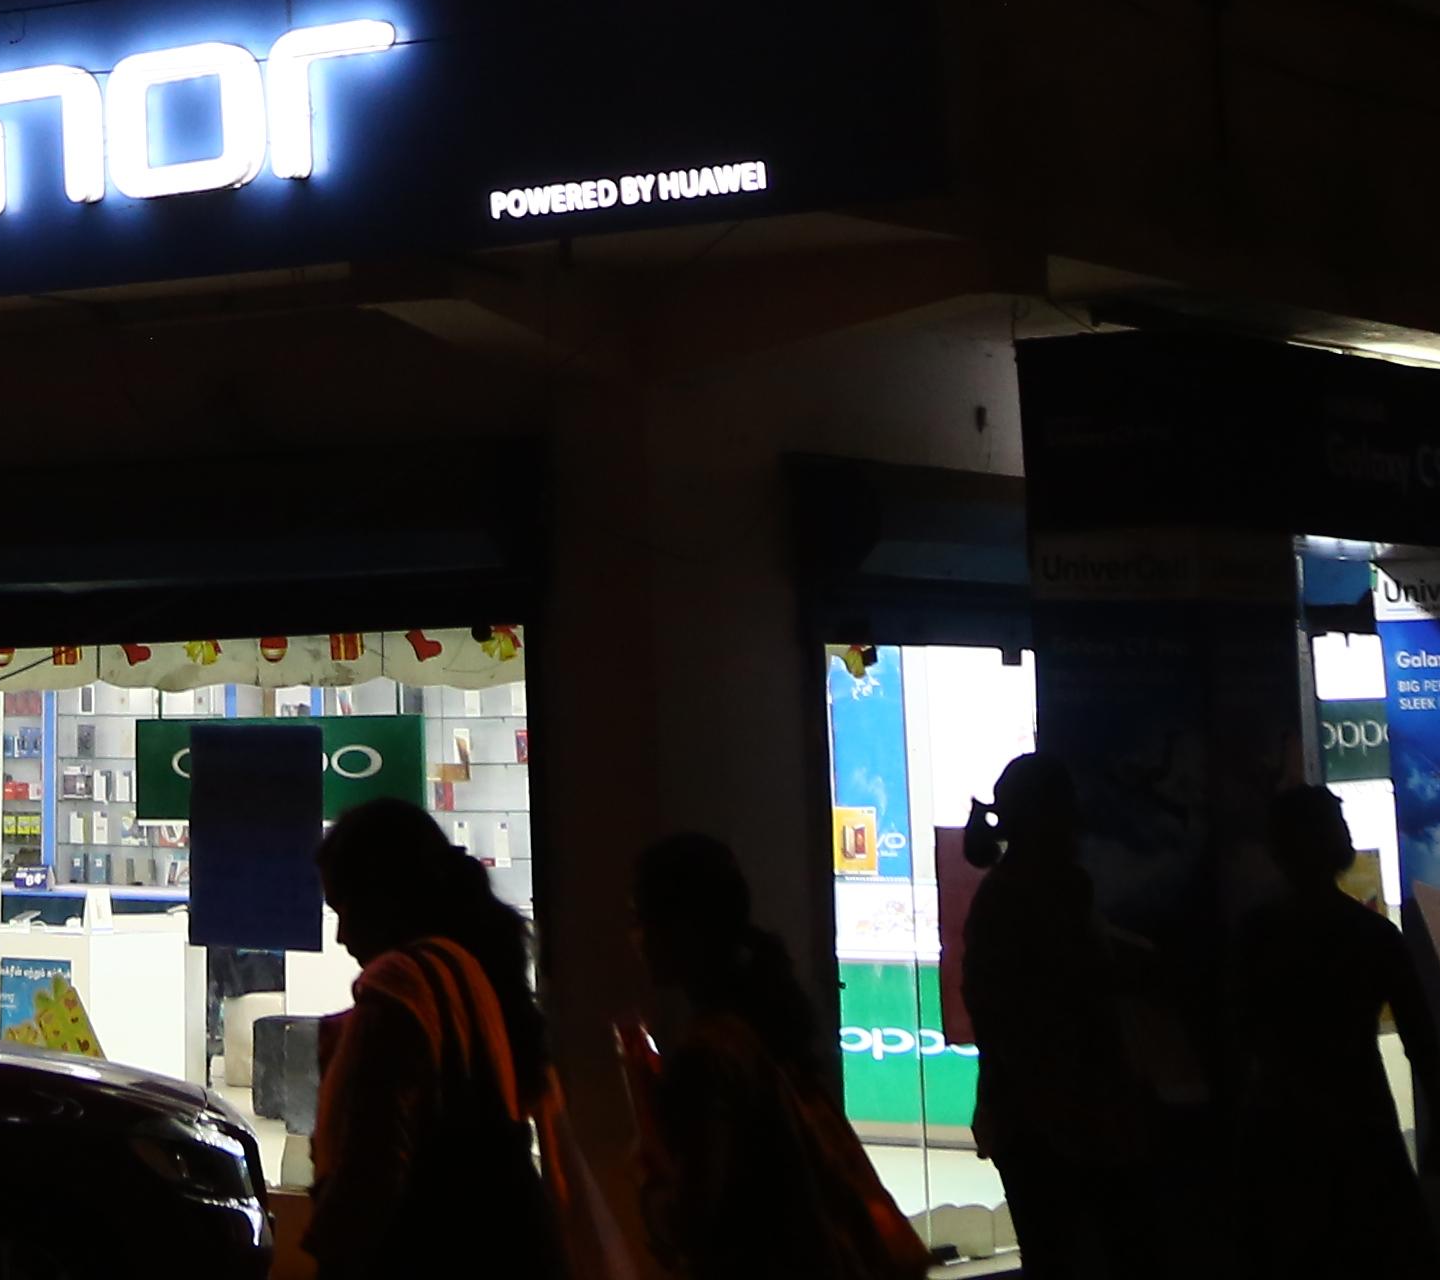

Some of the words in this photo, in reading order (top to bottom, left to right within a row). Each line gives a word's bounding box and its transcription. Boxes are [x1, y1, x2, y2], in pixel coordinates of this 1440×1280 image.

[490, 178, 618, 220] POWERED
[620, 173, 656, 205] BY
[657, 161, 768, 201] HUAWEI
[1397, 679, 1421, 692] BIG
[1399, 697, 1437, 710] SLEEK
